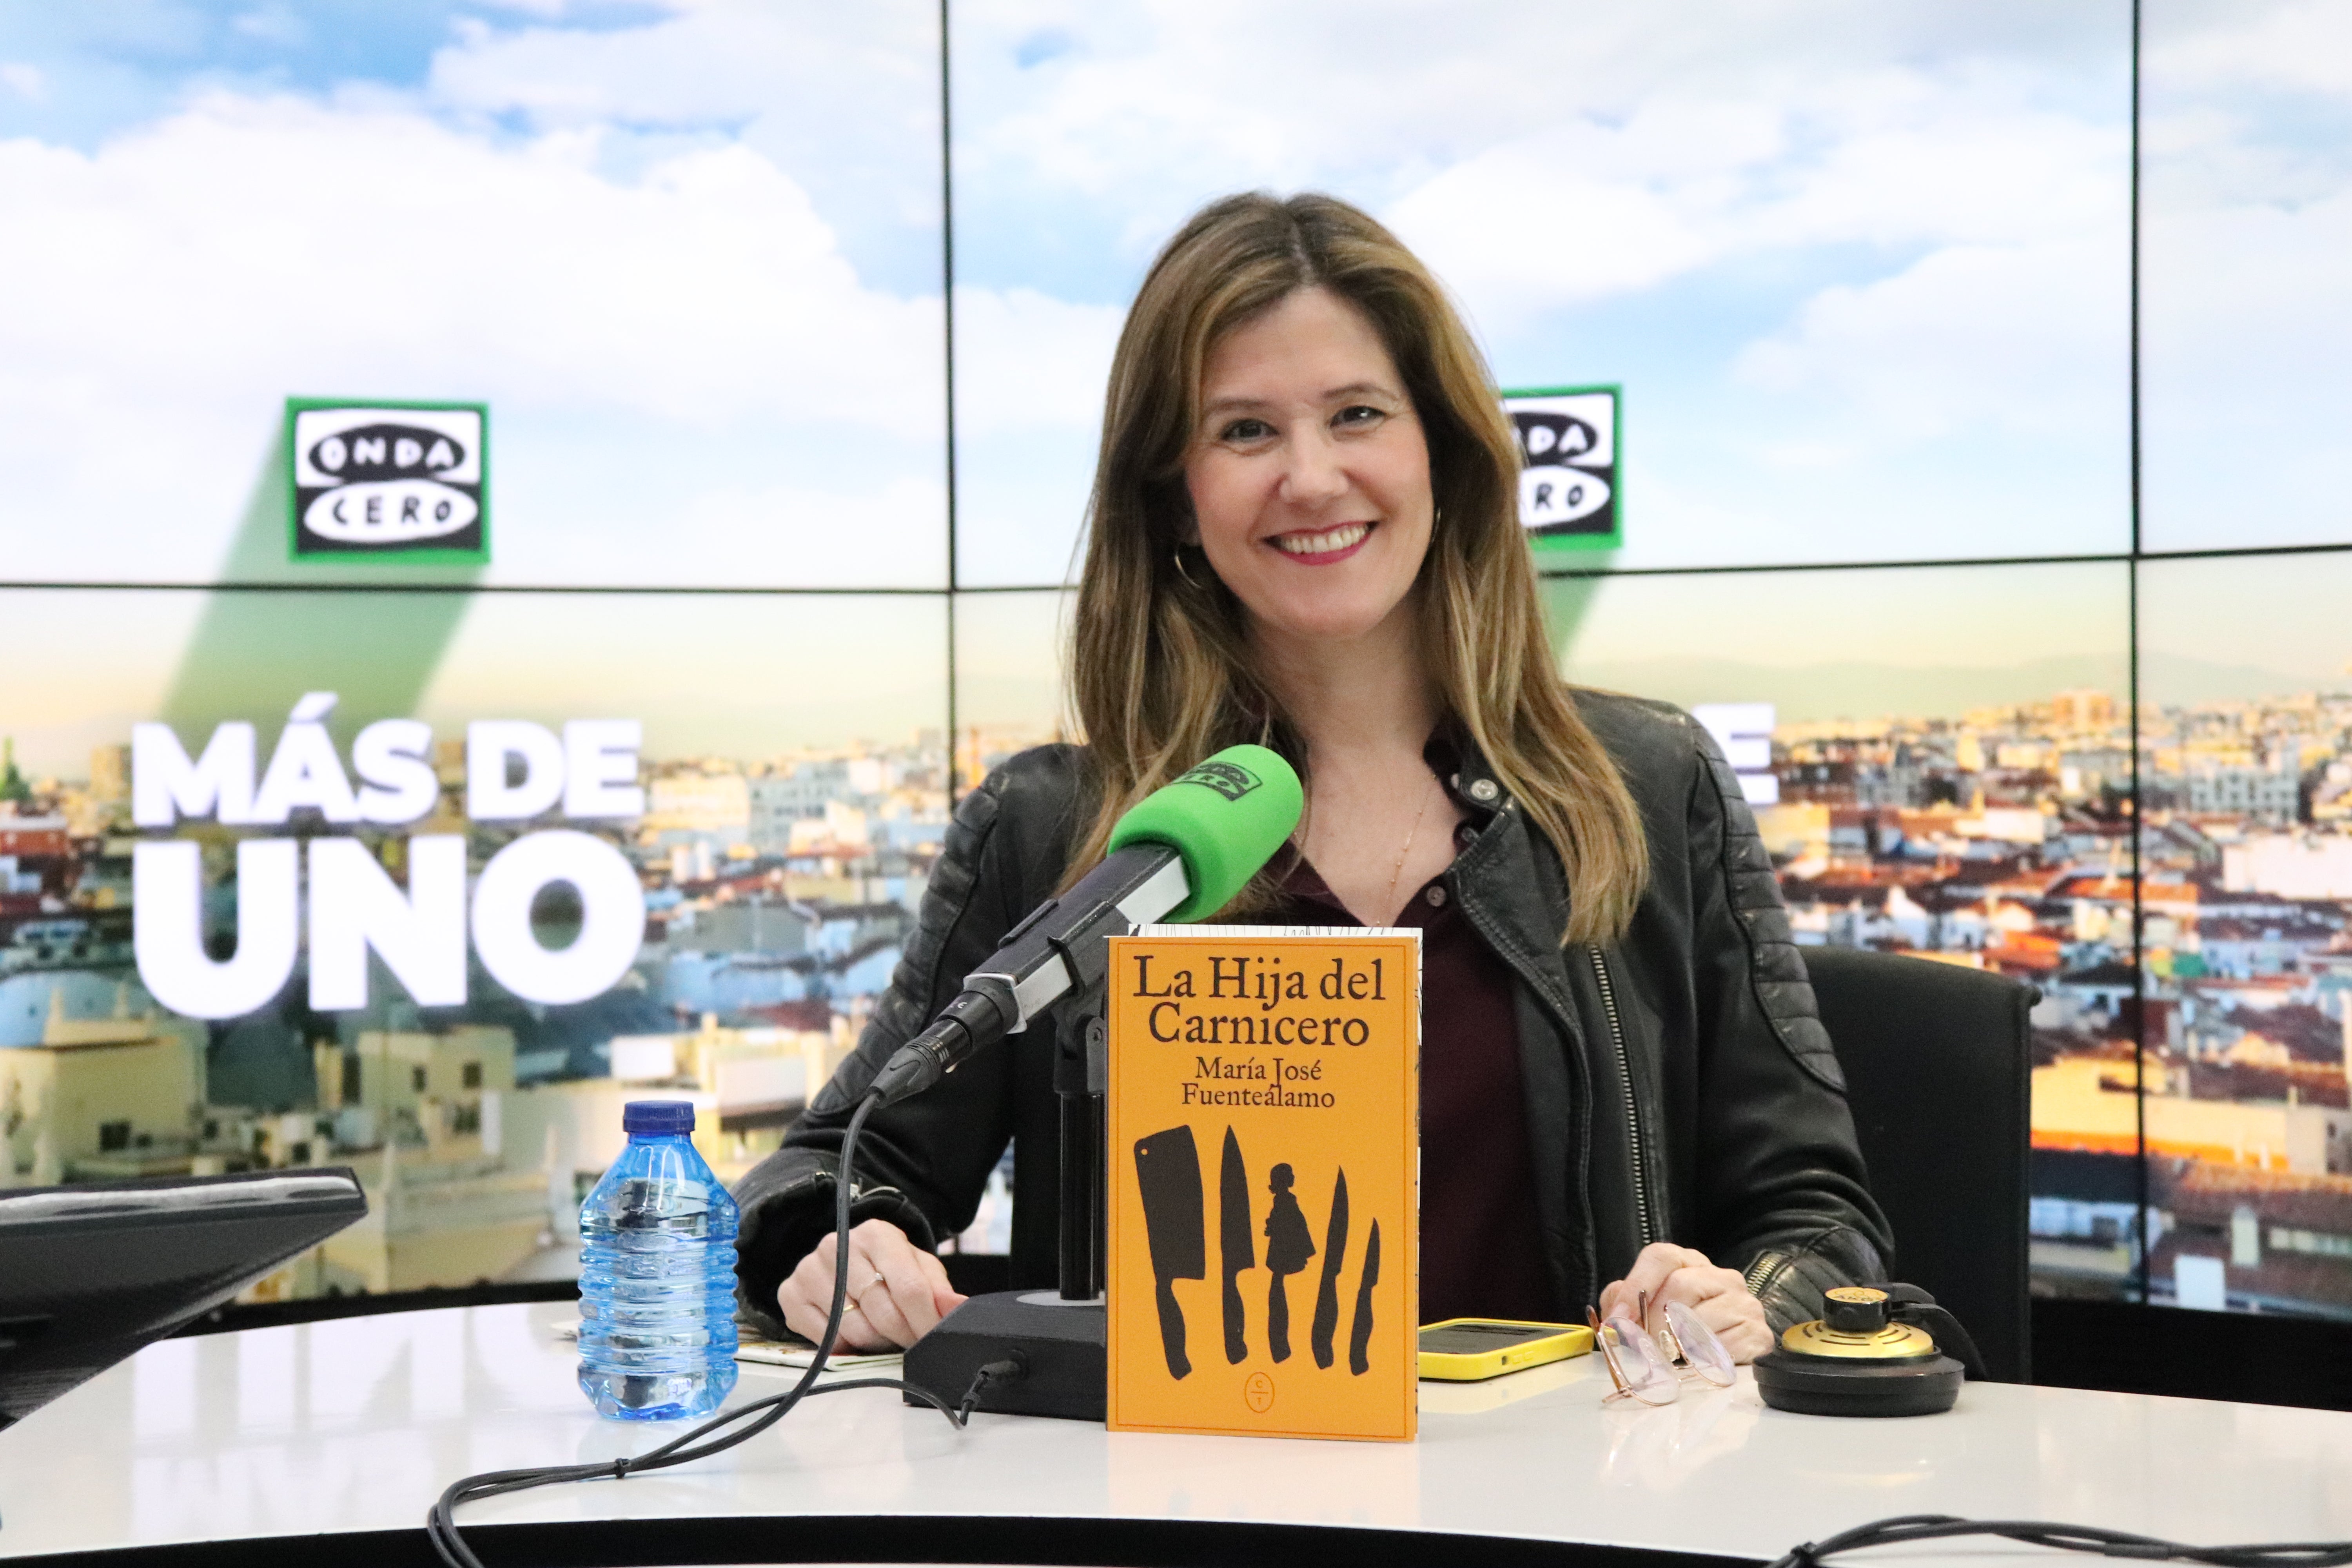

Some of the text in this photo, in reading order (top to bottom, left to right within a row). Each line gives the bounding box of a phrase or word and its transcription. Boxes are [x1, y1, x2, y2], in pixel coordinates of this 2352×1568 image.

[318, 436, 456, 471] ONDA
[1512, 424, 1589, 456] DA
[332, 495, 452, 526] CERO
[1534, 482, 1584, 510] RO
[132, 691, 645, 827] MÁS DE
[132, 829, 647, 1021] UNO
[1132, 955, 1386, 1012] La Hija del
[1149, 1001, 1370, 1047] Carnicero
[1195, 1056, 1321, 1087] María José
[1181, 1083, 1335, 1108] Fuenteálamo
